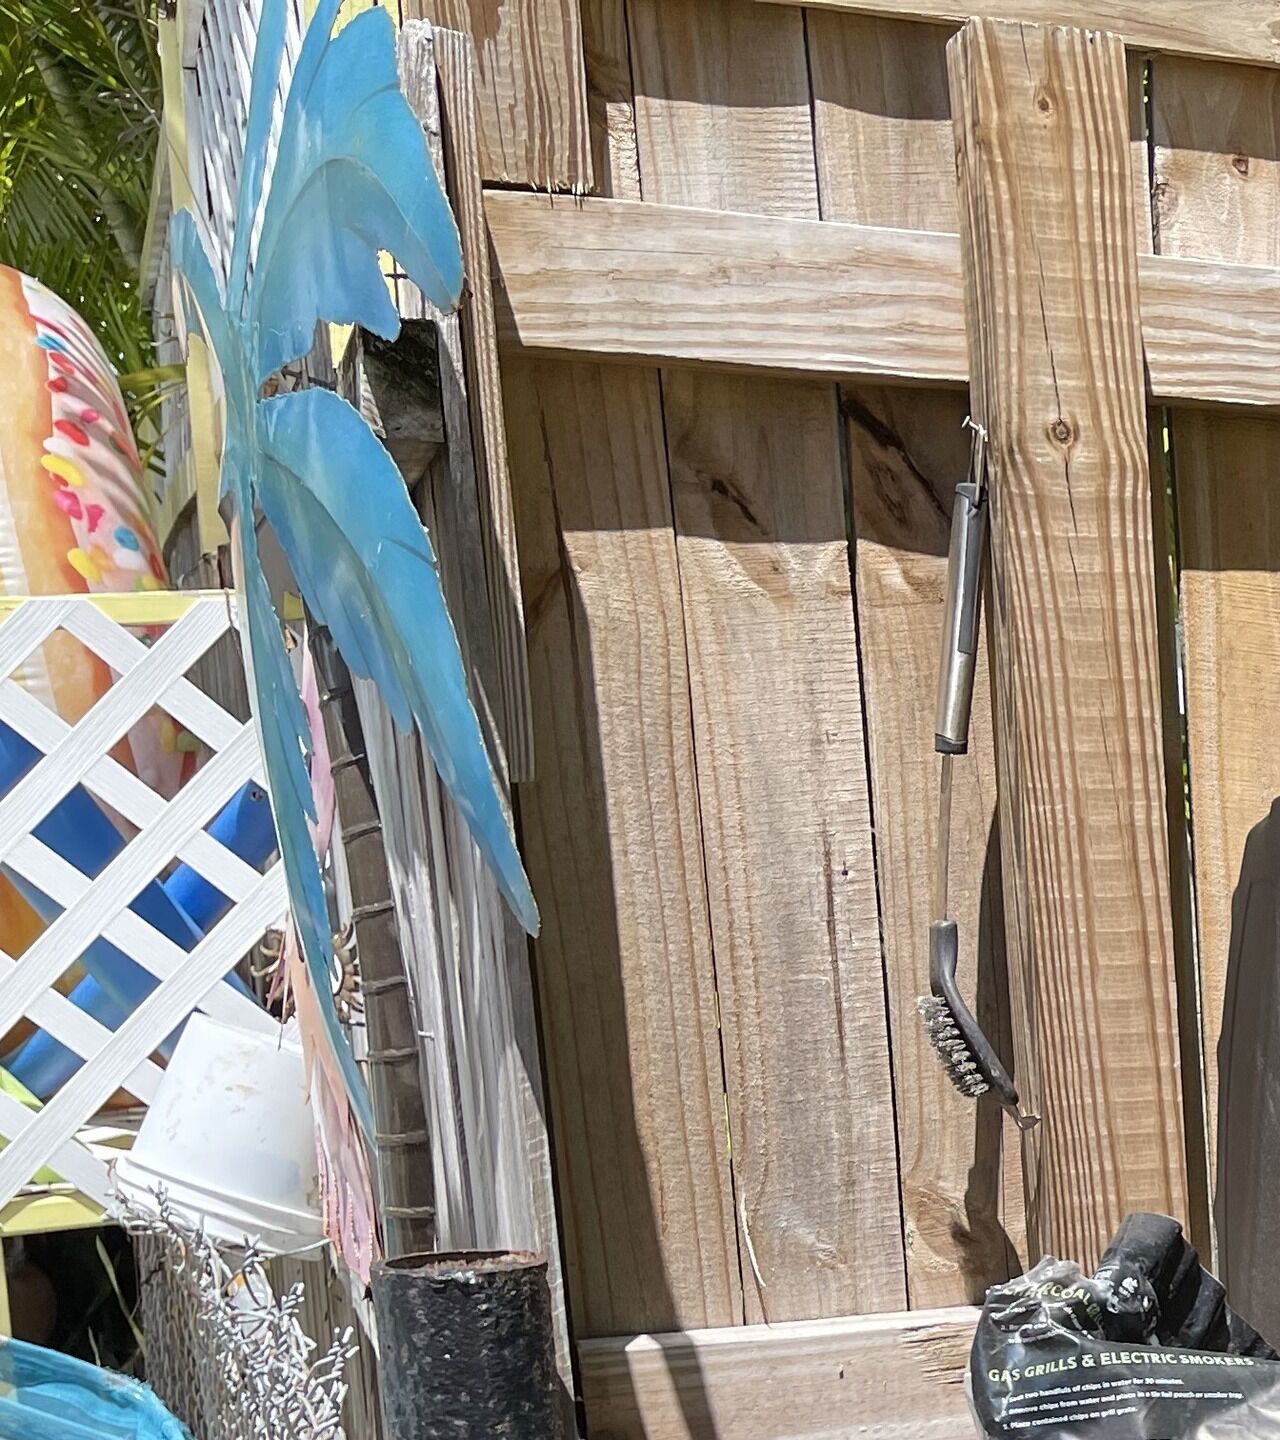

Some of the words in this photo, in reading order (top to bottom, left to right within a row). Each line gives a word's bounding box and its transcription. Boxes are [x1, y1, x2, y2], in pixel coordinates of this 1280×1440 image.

[988, 1368, 1020, 1382] GAS
[1024, 1357, 1077, 1378] GRILLS
[1081, 1353, 1096, 1368] &
[1100, 1351, 1178, 1366] ELECTRIC
[1179, 1354, 1254, 1366] SMOKERS
[1081, 1383, 1101, 1391] chips
[1111, 1379, 1132, 1387] water
[1060, 1400, 1078, 1408] from
[1101, 1394, 1115, 1403] and
[1116, 1392, 1136, 1401] place
[1032, 1415, 1068, 1426] contained
[1069, 1413, 1089, 1421] chips
